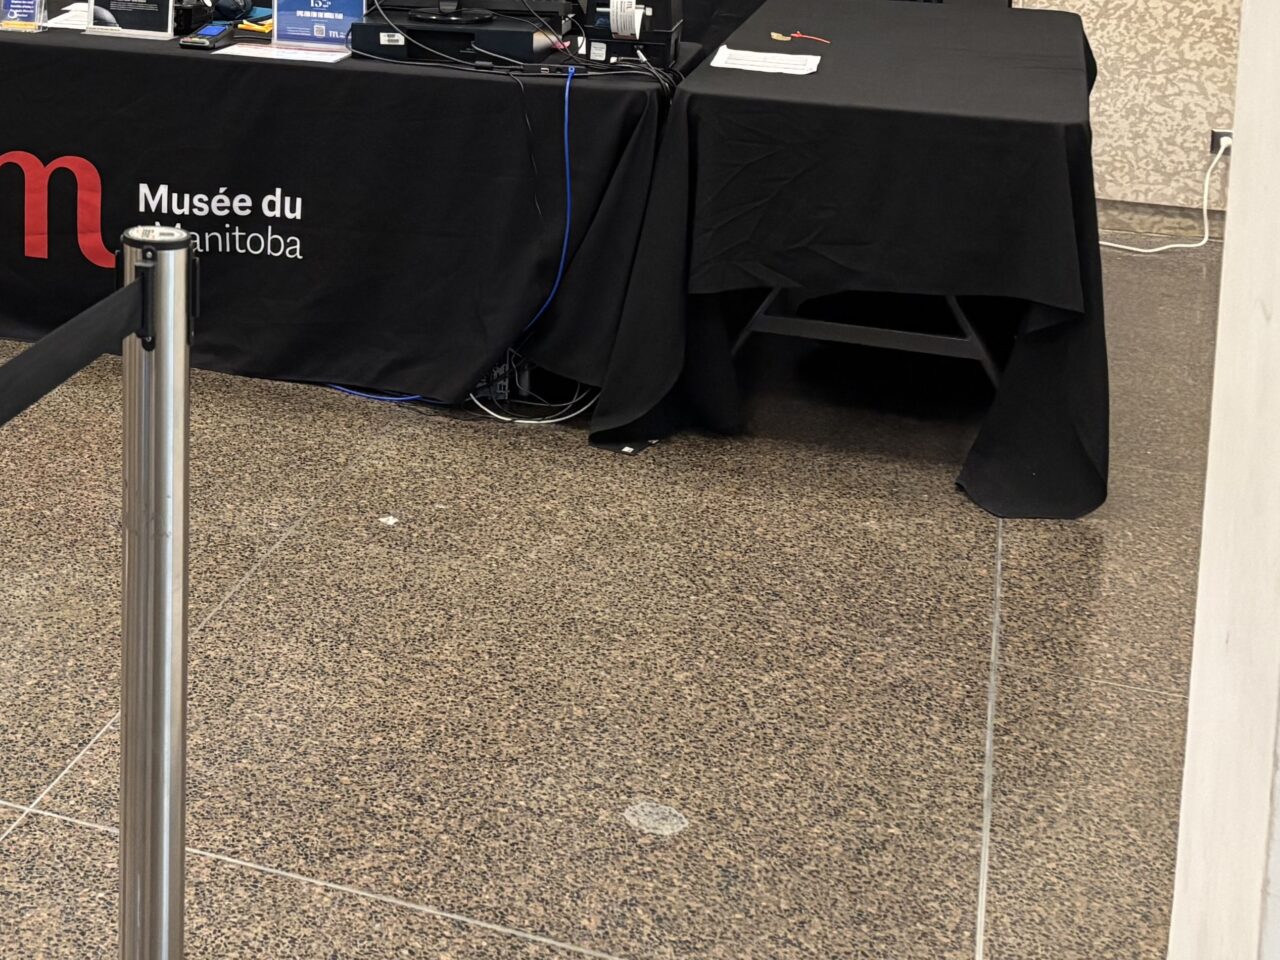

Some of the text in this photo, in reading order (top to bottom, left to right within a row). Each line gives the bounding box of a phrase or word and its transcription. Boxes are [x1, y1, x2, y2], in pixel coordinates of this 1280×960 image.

[138, 182, 303, 220] Musée du
[154, 220, 304, 260] anitoba
